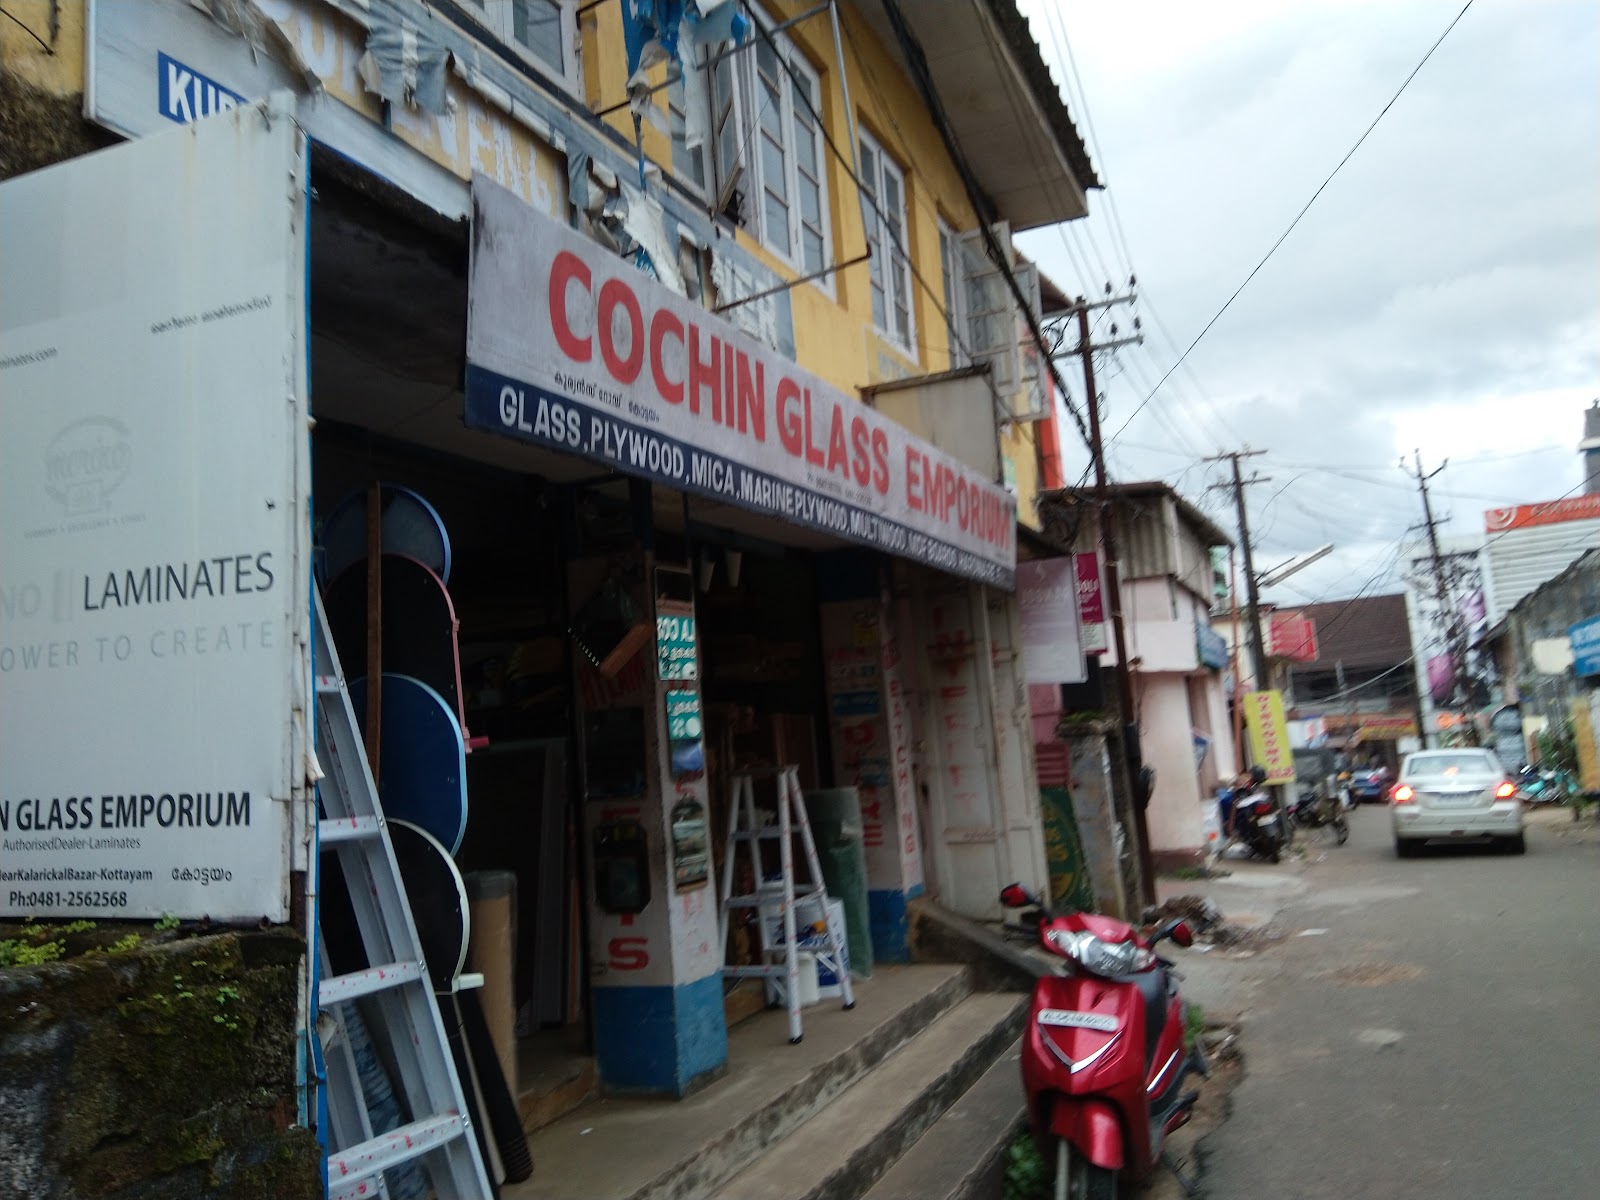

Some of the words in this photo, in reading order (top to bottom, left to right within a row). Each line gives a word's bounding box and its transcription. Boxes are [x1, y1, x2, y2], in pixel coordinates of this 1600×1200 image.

[549, 249, 766, 443] COCHIN
[775, 376, 890, 497] GLASS
[904, 445, 1012, 550] EMPORIUM
[84, 551, 275, 611] LAMINATES
[95, 634, 132, 663] TO
[150, 620, 274, 659] CREATE
[16, 796, 93, 831] GLASS
[100, 791, 250, 829] EMPORIUM
